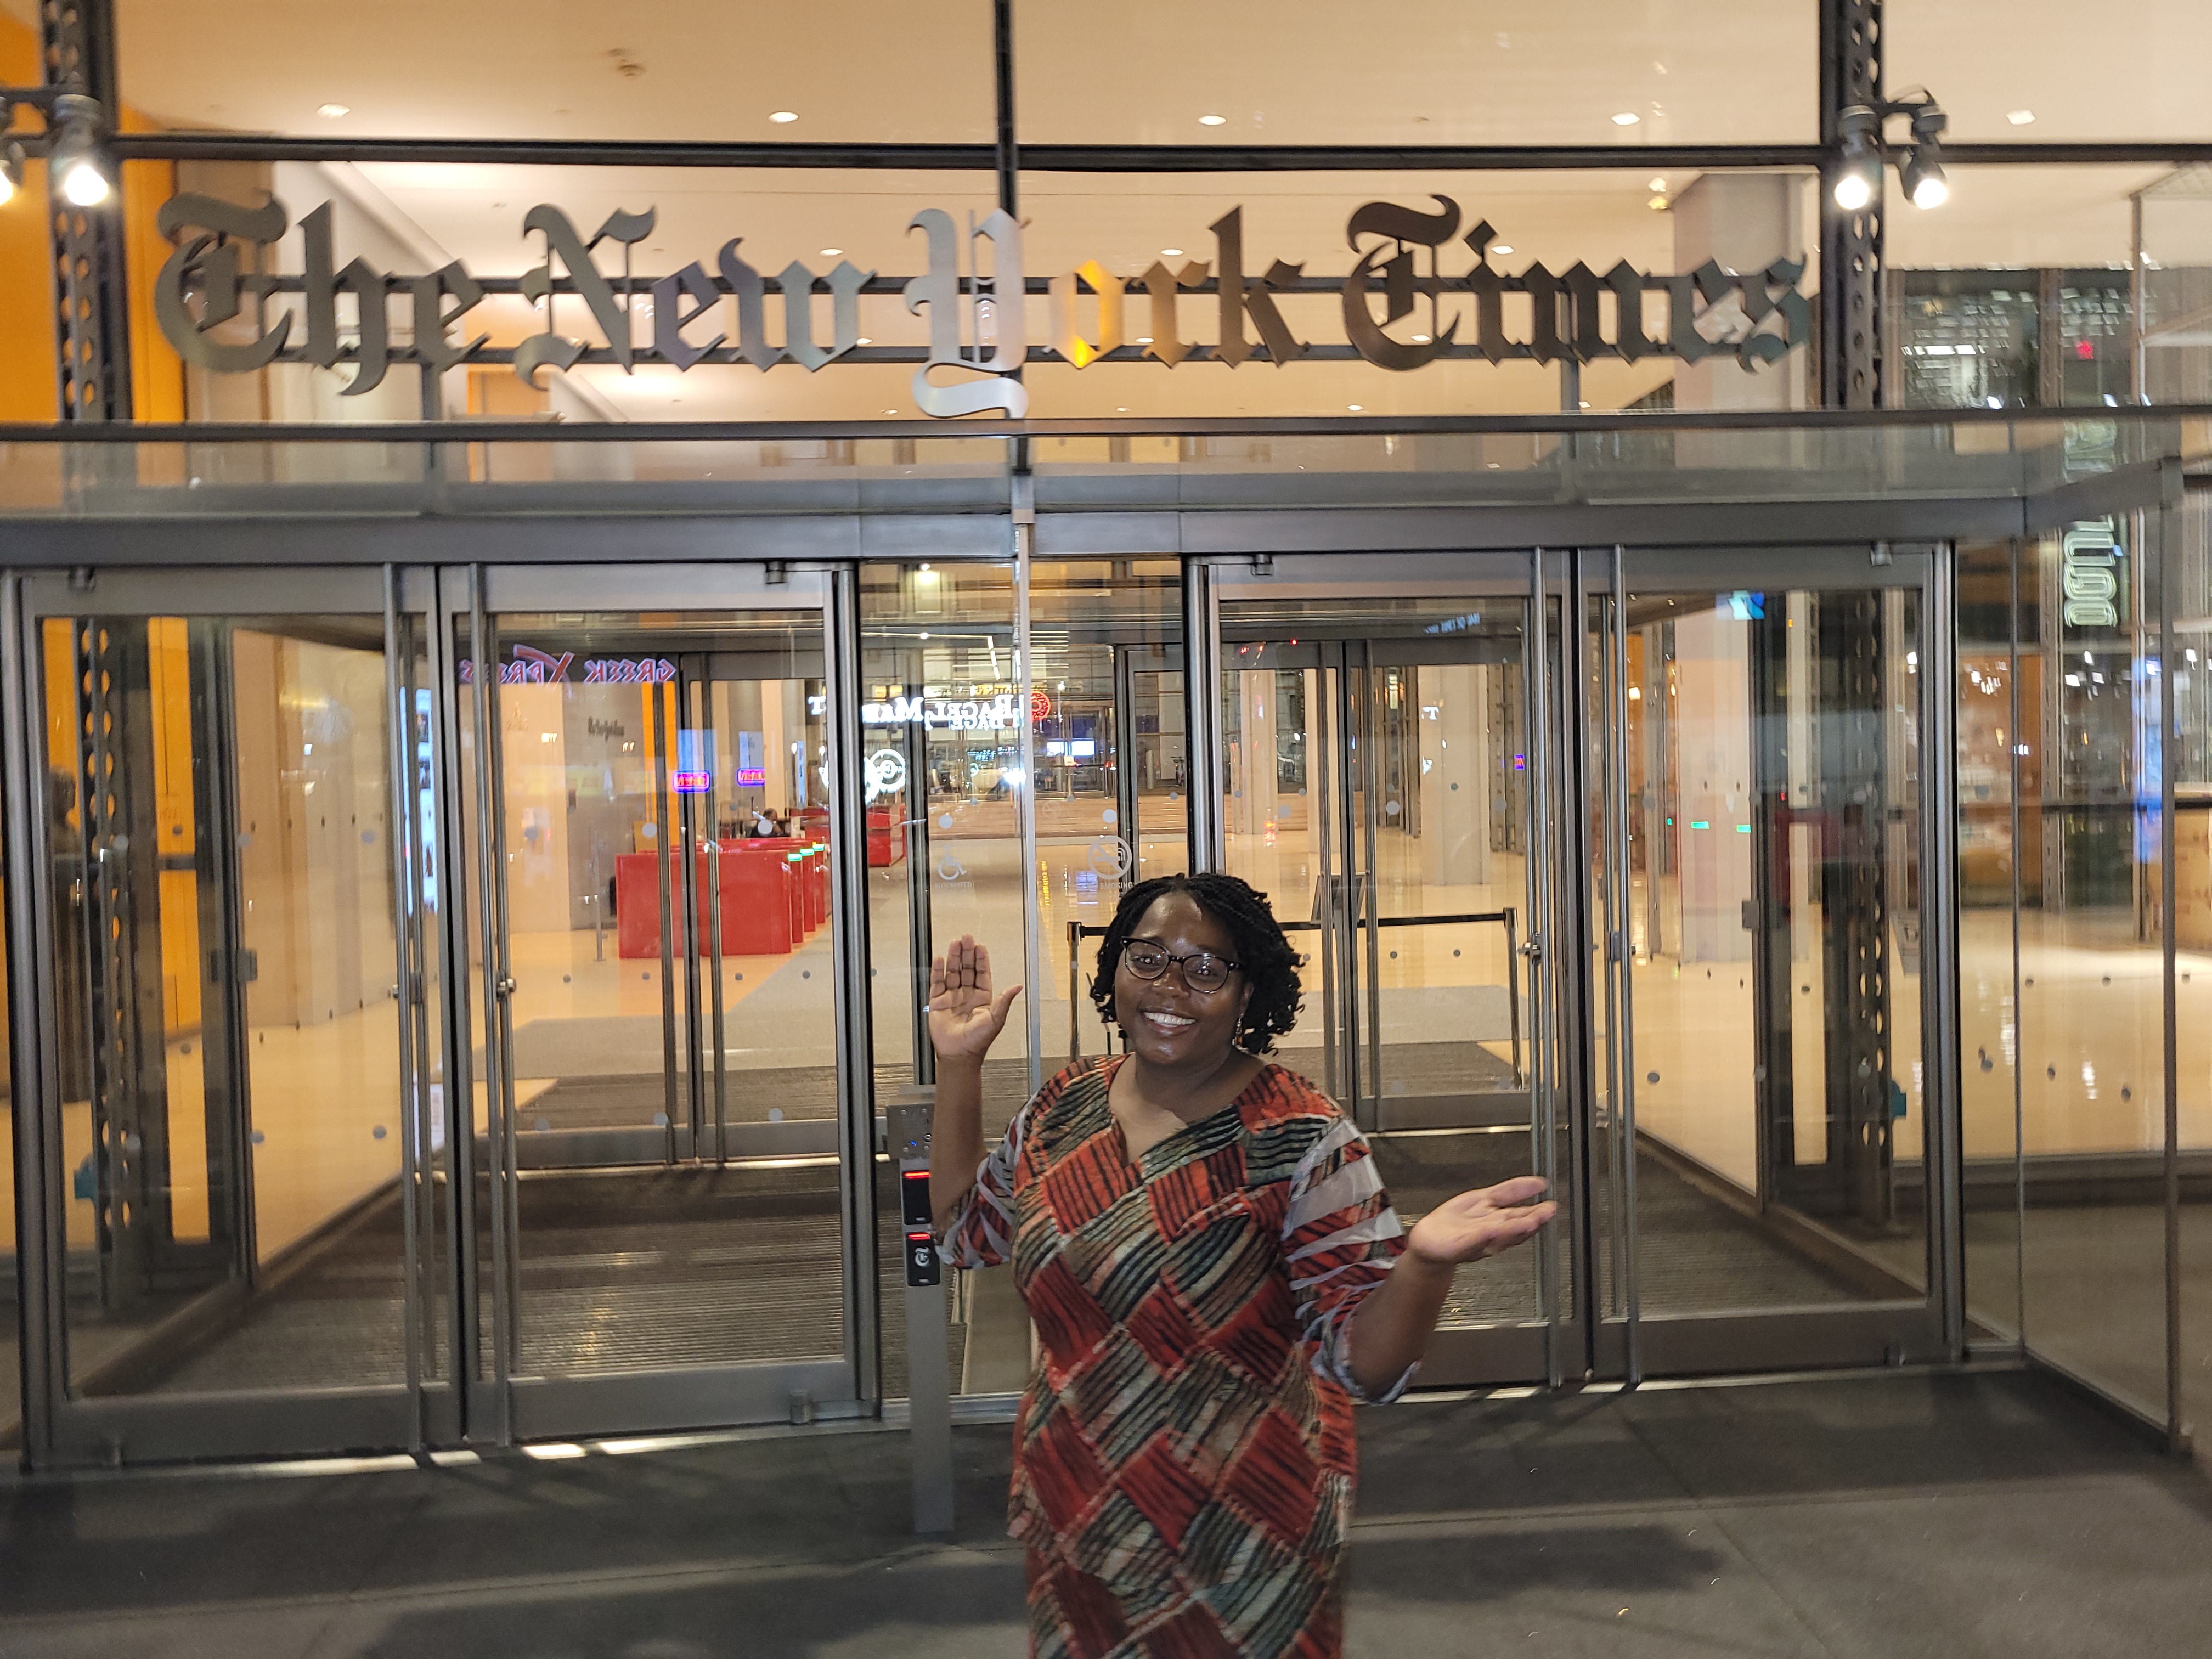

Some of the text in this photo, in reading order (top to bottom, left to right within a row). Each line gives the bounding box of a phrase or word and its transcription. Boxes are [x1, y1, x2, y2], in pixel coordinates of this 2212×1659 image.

[155, 191, 1810, 419] The New York Times
